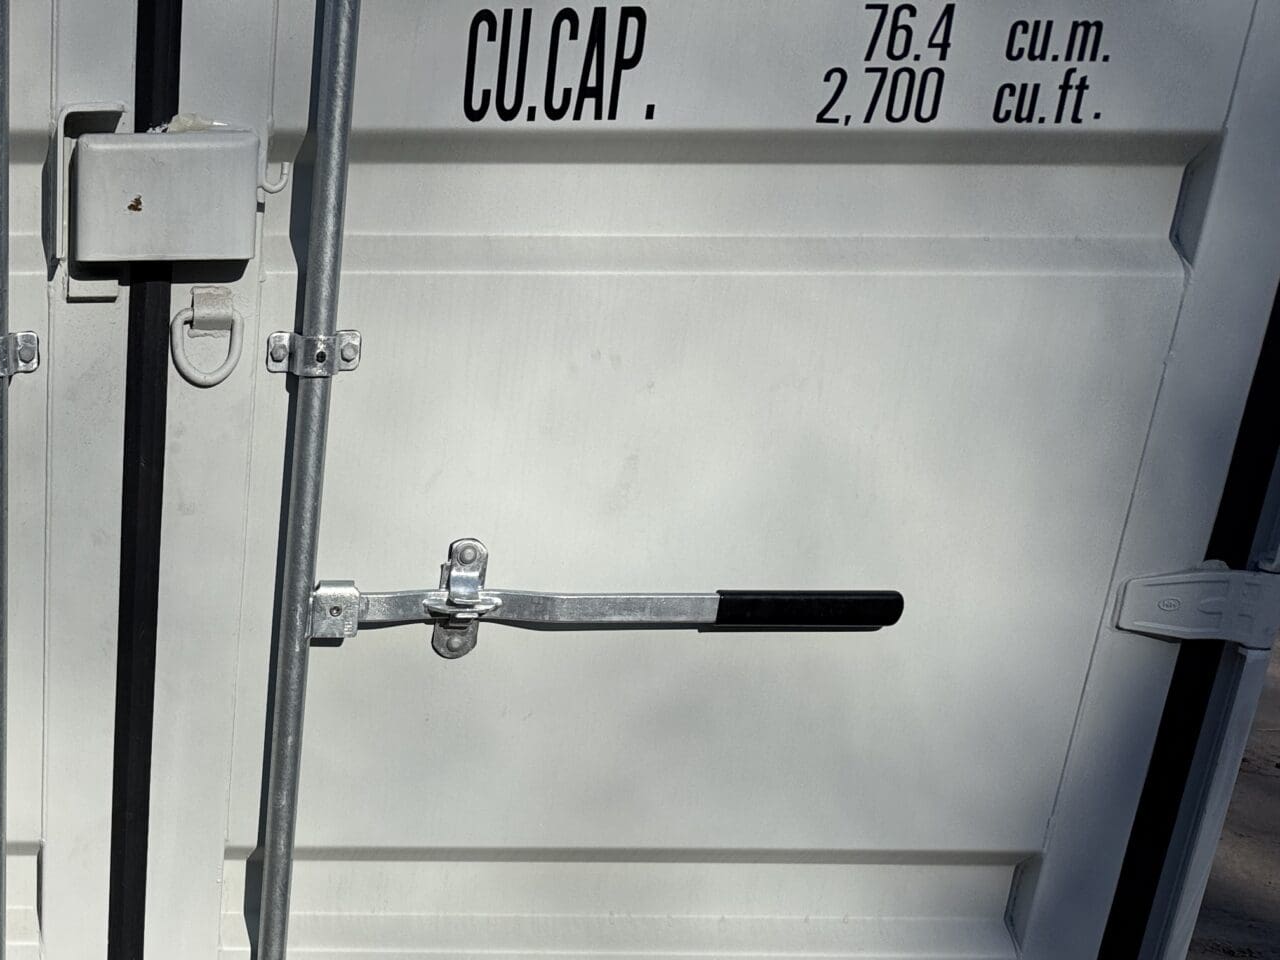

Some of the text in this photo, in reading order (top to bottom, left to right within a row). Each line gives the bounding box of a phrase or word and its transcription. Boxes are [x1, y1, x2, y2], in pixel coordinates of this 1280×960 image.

[864, 2, 1111, 62] 76.4 cu.m.
[462, 5, 656, 122] CU.CAP.
[816, 66, 945, 125] 2,700
